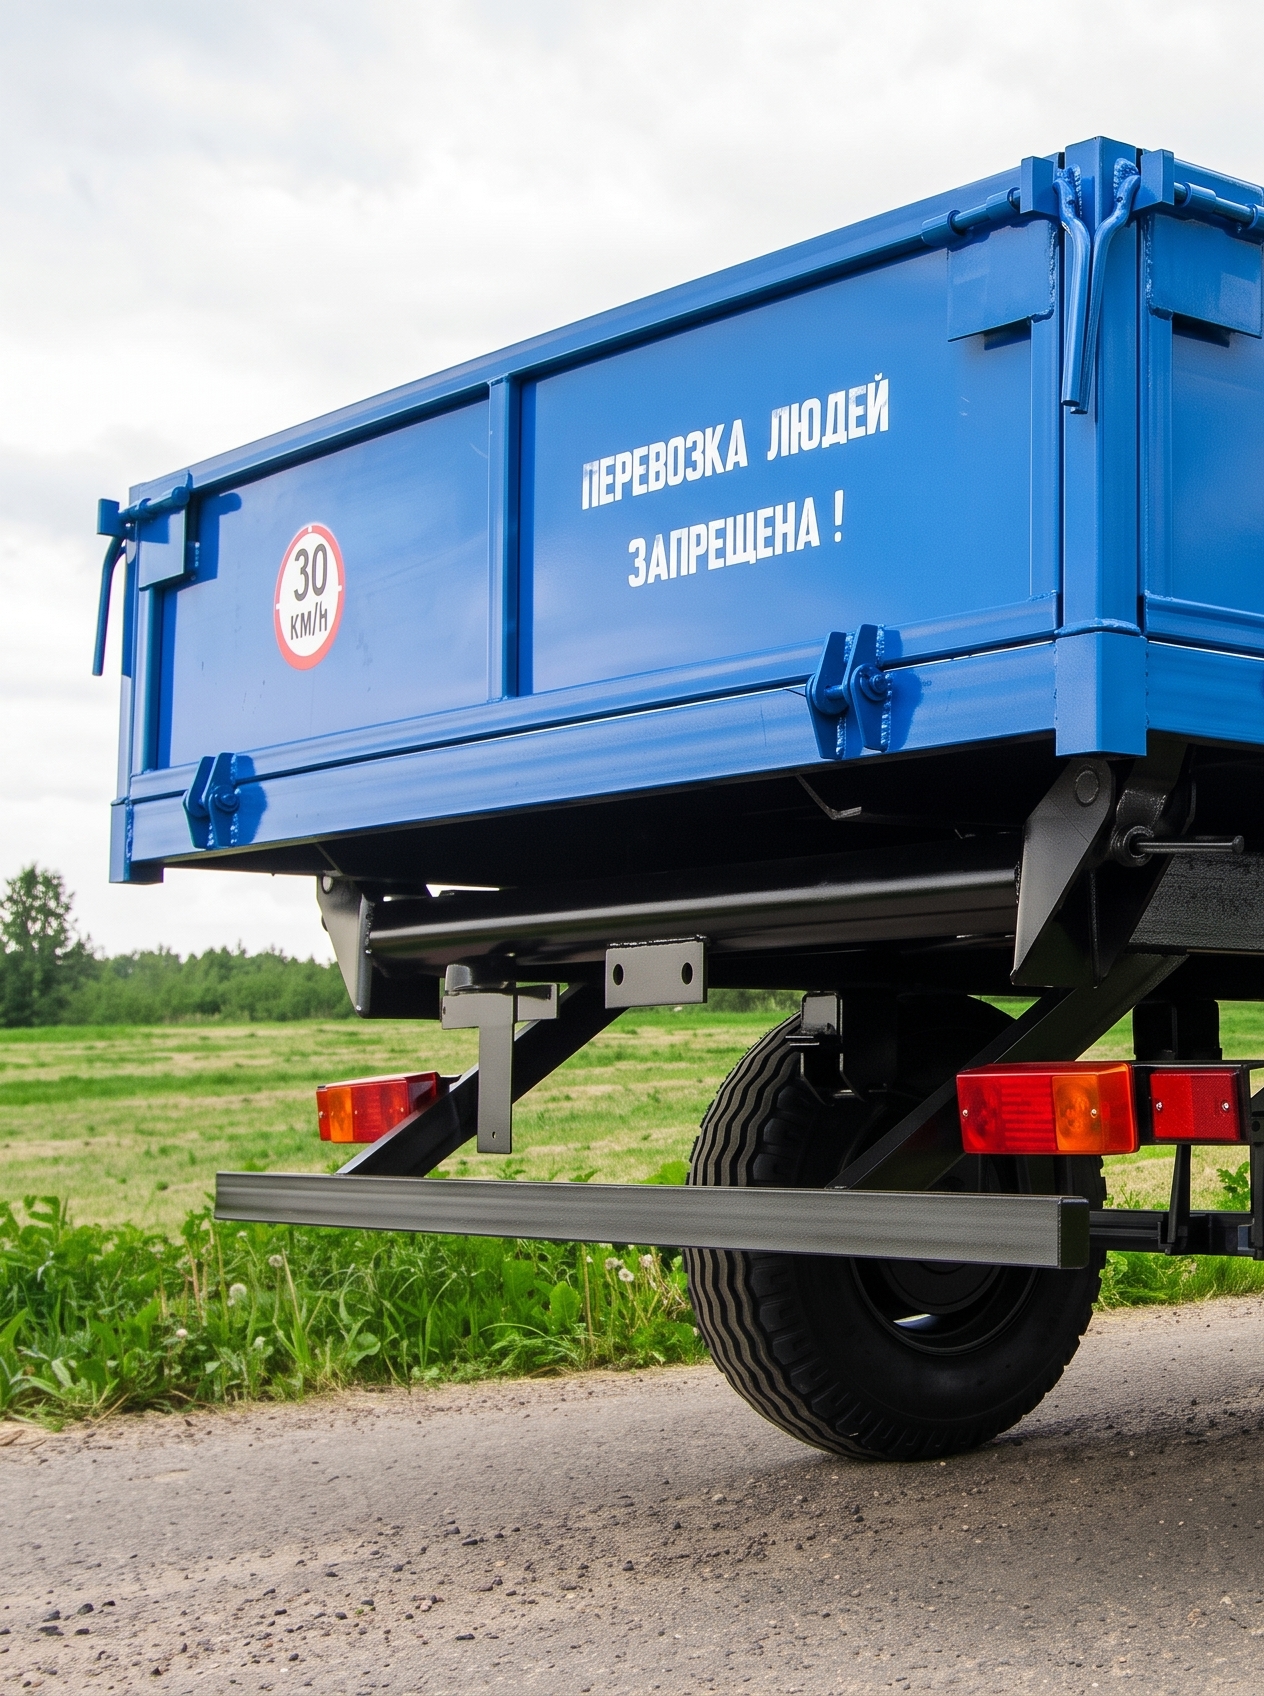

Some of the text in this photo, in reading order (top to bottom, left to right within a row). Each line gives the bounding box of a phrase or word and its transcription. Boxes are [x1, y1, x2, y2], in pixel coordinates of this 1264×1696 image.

[581, 372, 890, 511] ПЕРЕВОЗКА ЛЮДЕЙ
[293, 543, 328, 602] 30
[627, 496, 821, 588] ЗАПРЕЩЕНА
